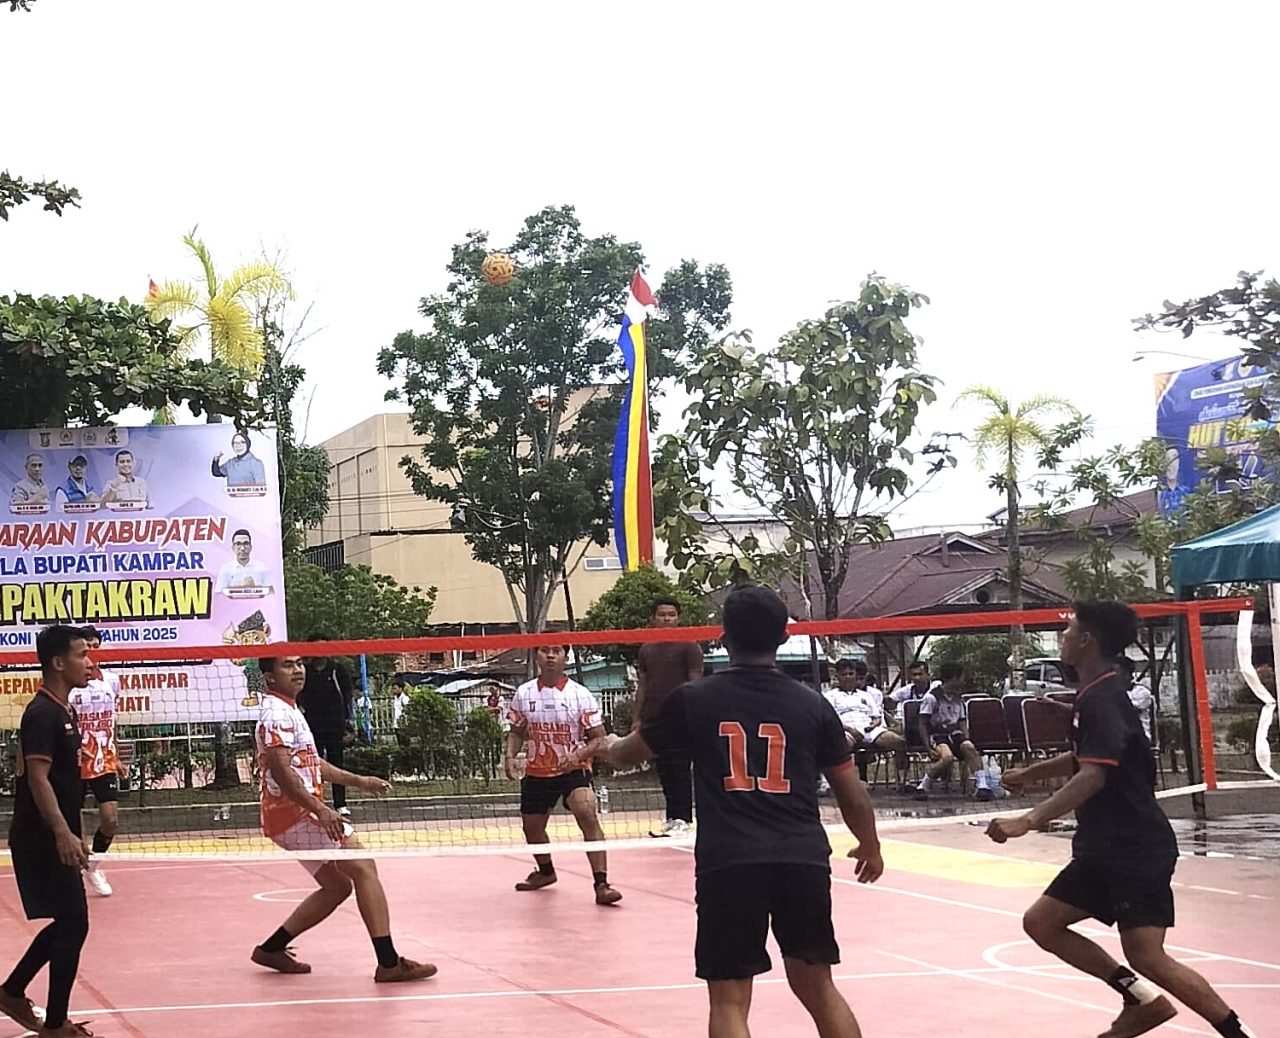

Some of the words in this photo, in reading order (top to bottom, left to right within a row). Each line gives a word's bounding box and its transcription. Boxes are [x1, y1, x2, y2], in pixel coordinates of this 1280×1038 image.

[86, 517, 227, 549] KABUPATEN
[35, 555, 107, 575] BUPATI
[114, 551, 204, 571] KAMPAR
[0, 632, 31, 646] KONI
[143, 627, 177, 640] 2025
[119, 672, 189, 690] KAMPAR
[719, 721, 791, 793] 11
